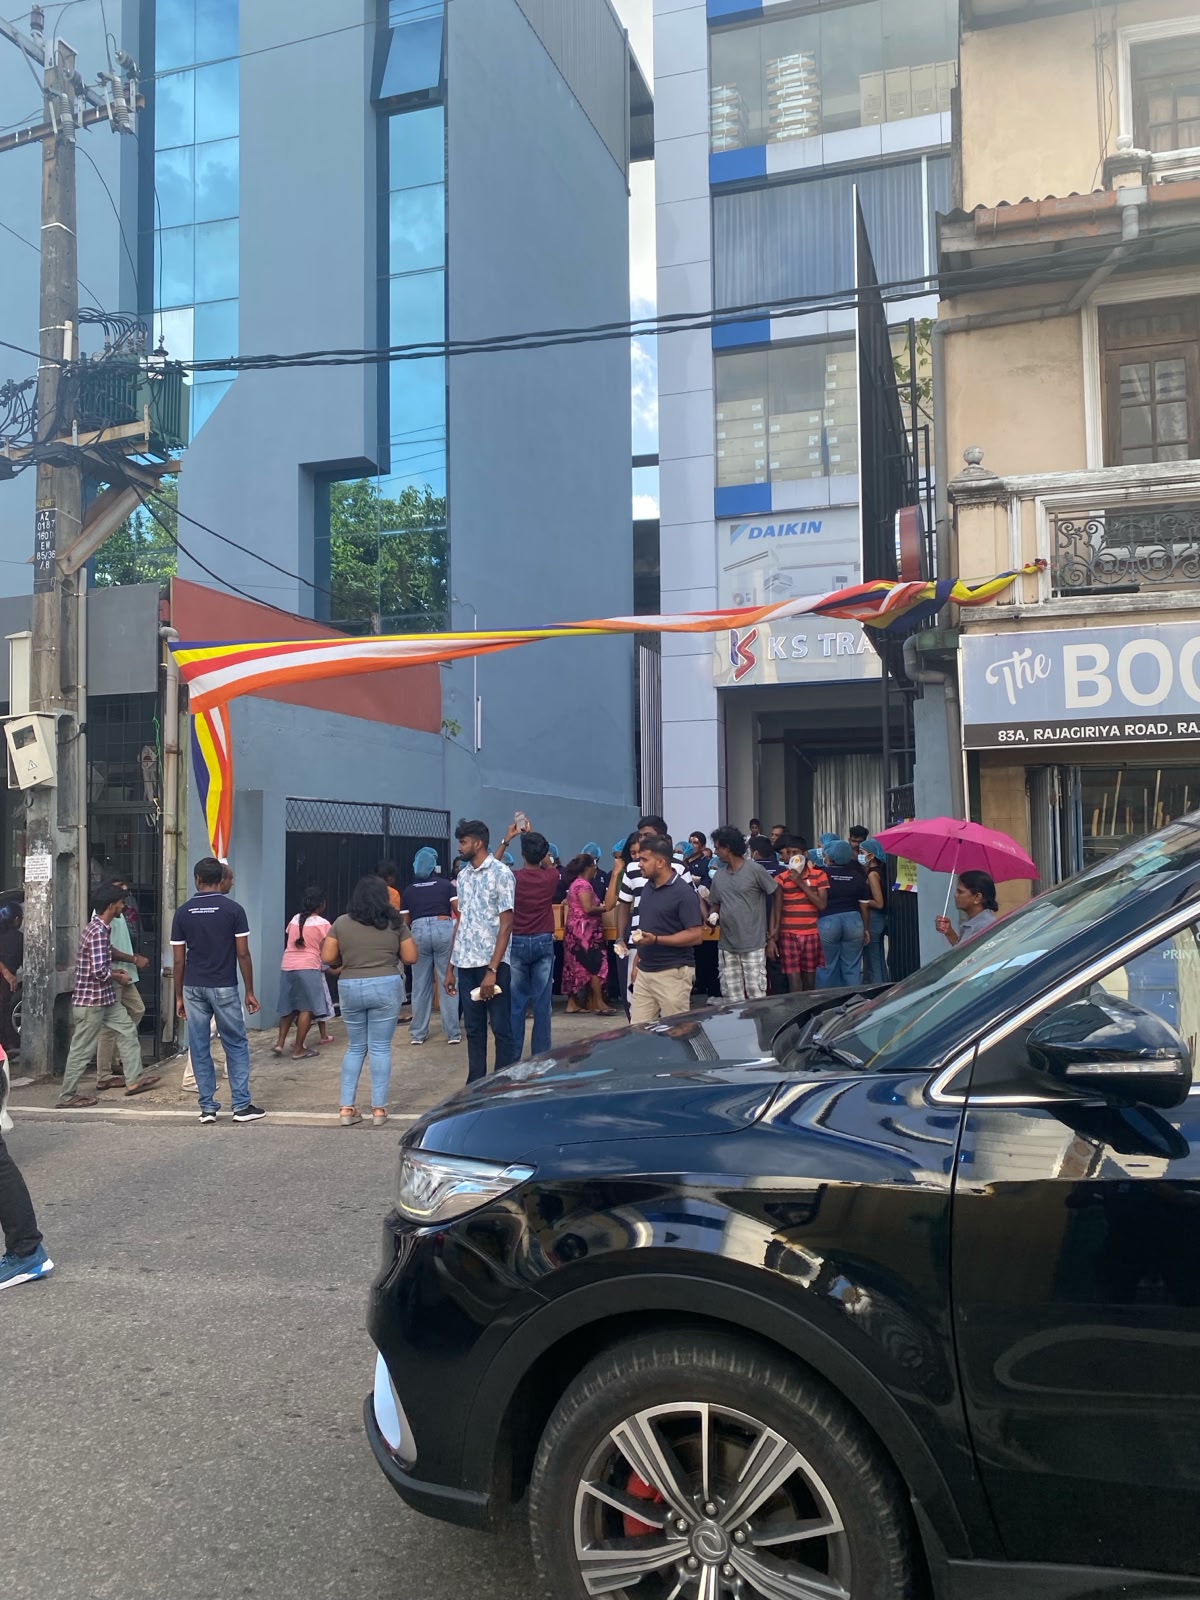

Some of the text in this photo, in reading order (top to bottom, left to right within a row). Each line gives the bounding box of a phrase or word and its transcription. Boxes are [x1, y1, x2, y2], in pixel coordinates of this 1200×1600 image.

[37, 520, 56, 531] 0187
[40, 512, 49, 521] AZ
[748, 521, 822, 540] DAIKIN
[768, 632, 876, 661] KS TRA
[985, 647, 1051, 705] The
[997, 721, 1200, 743] 83A, RAJAGIRIYA ROAD, RA
